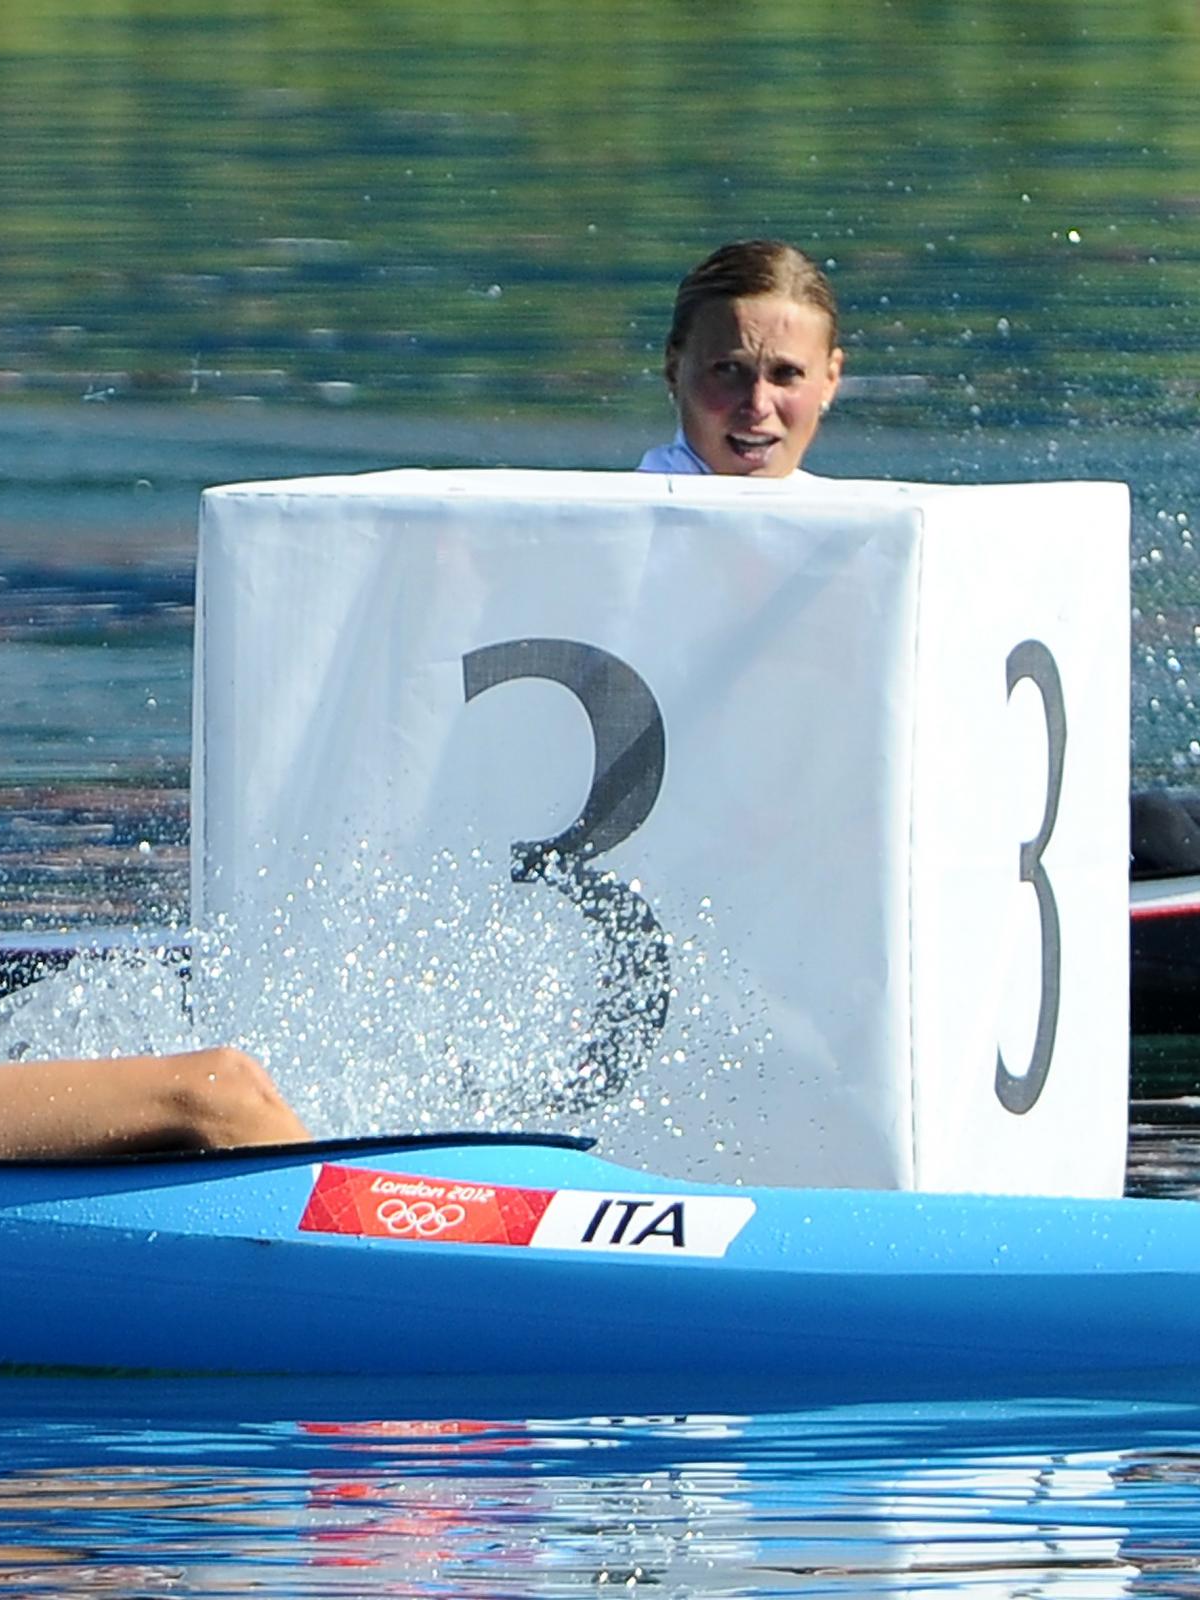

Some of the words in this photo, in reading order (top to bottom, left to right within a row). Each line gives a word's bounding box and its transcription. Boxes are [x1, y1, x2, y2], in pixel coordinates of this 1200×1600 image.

[461, 637, 670, 1116] 3
[994, 638, 1067, 1116] 3
[370, 1176, 446, 1198] London
[446, 1184, 496, 1203] 2012
[581, 1198, 686, 1248] ITA
